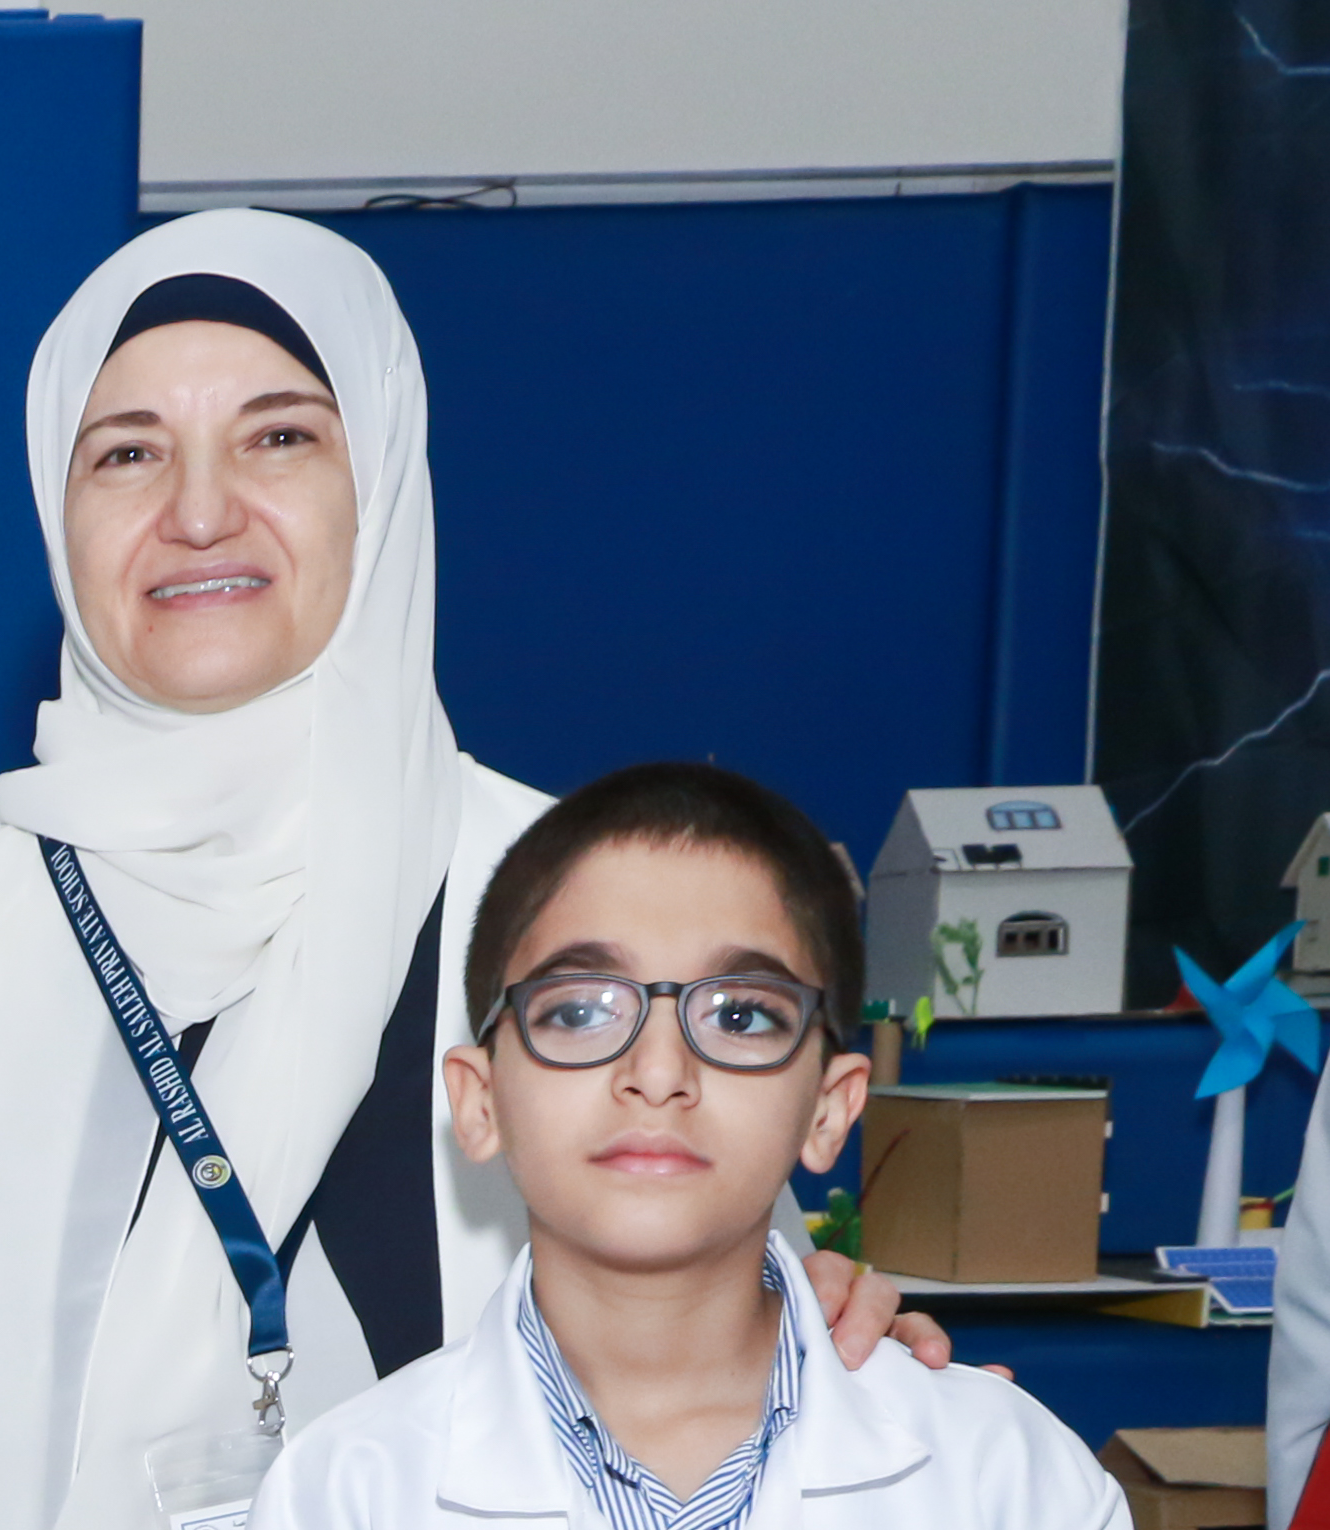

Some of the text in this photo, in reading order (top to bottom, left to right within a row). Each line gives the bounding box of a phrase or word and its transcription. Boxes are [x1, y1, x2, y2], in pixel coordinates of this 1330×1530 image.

[77, 908, 127, 985] PRIVATE
[109, 974, 155, 1037] SALEH
[137, 1029, 168, 1058] AL
[148, 1056, 197, 1124] RASHID
[177, 1117, 209, 1144] AL
